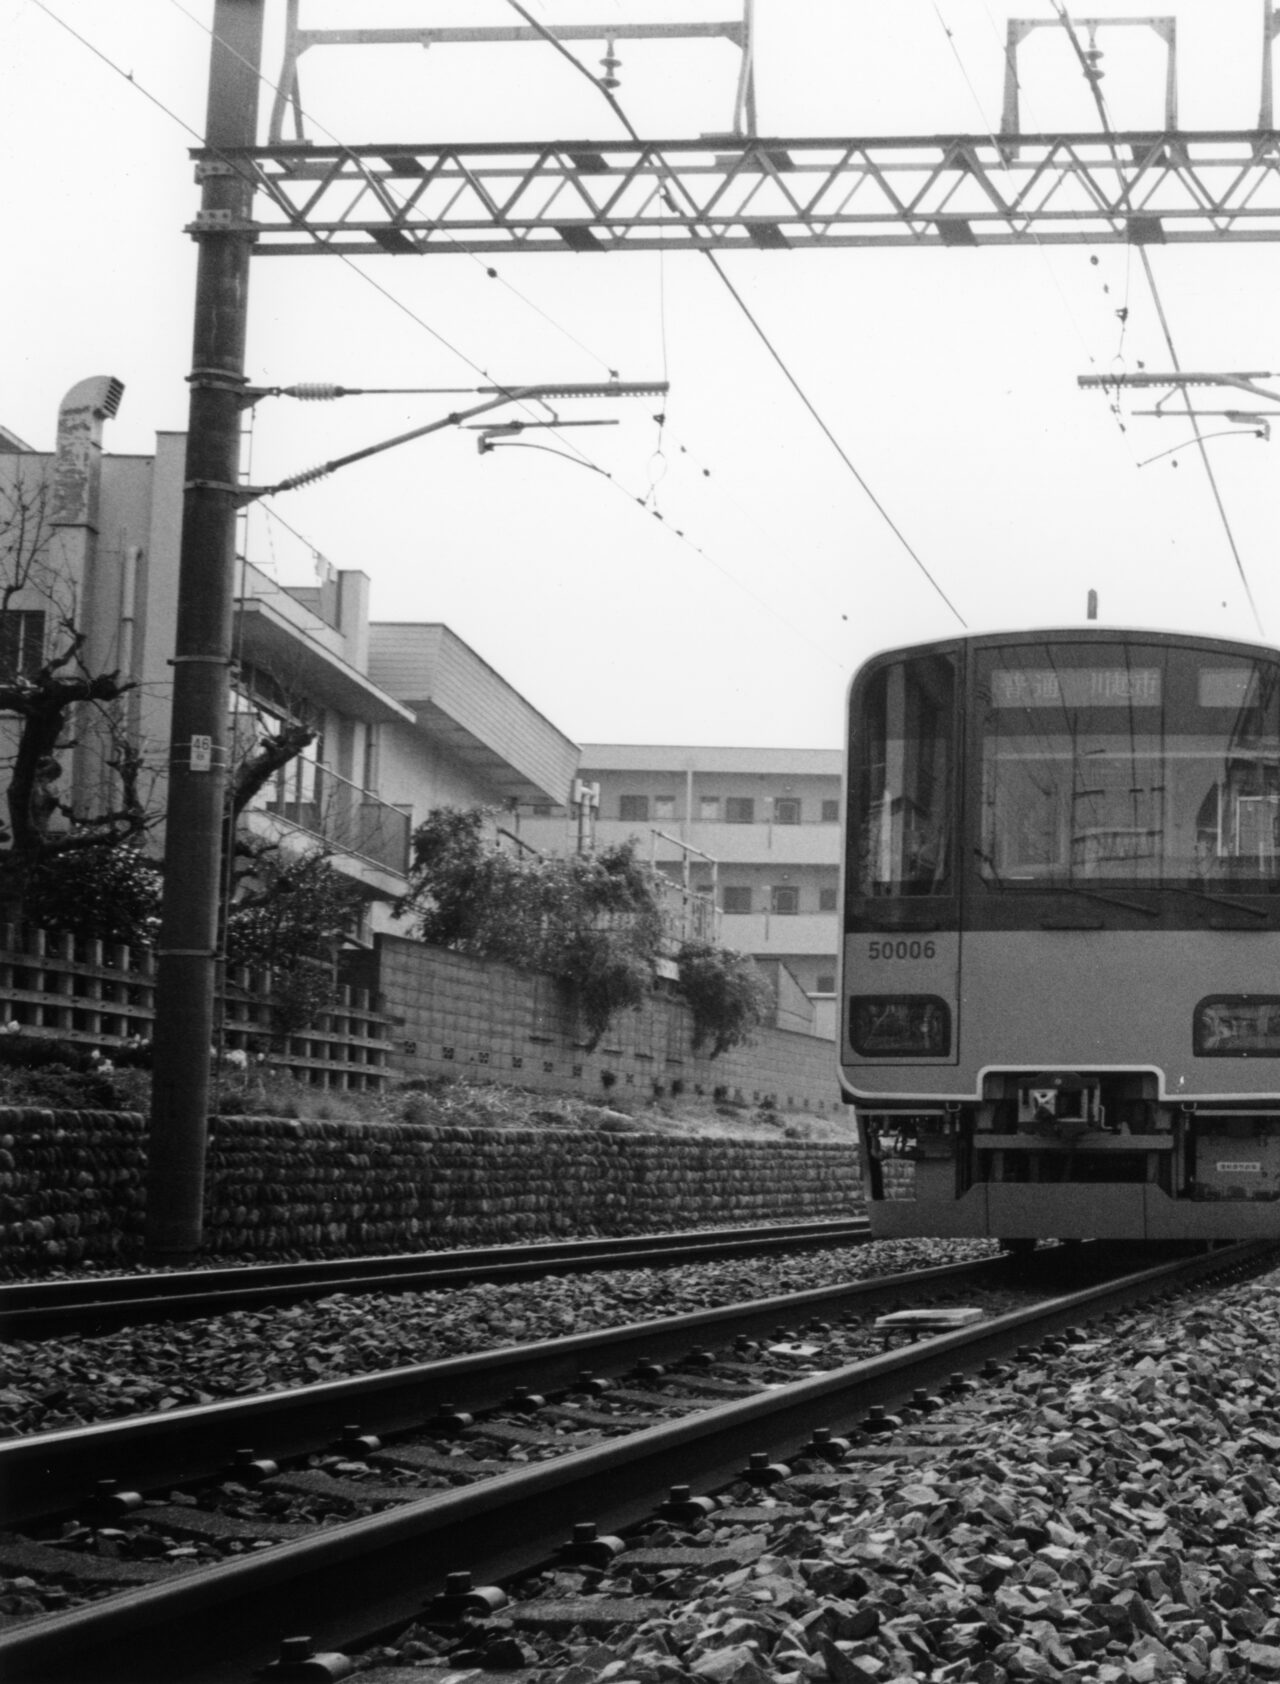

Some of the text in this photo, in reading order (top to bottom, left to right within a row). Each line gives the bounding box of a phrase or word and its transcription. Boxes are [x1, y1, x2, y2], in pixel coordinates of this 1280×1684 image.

[1002, 672, 1061, 699] 普通
[193, 737, 210, 751] 46
[868, 940, 936, 960] 50006
